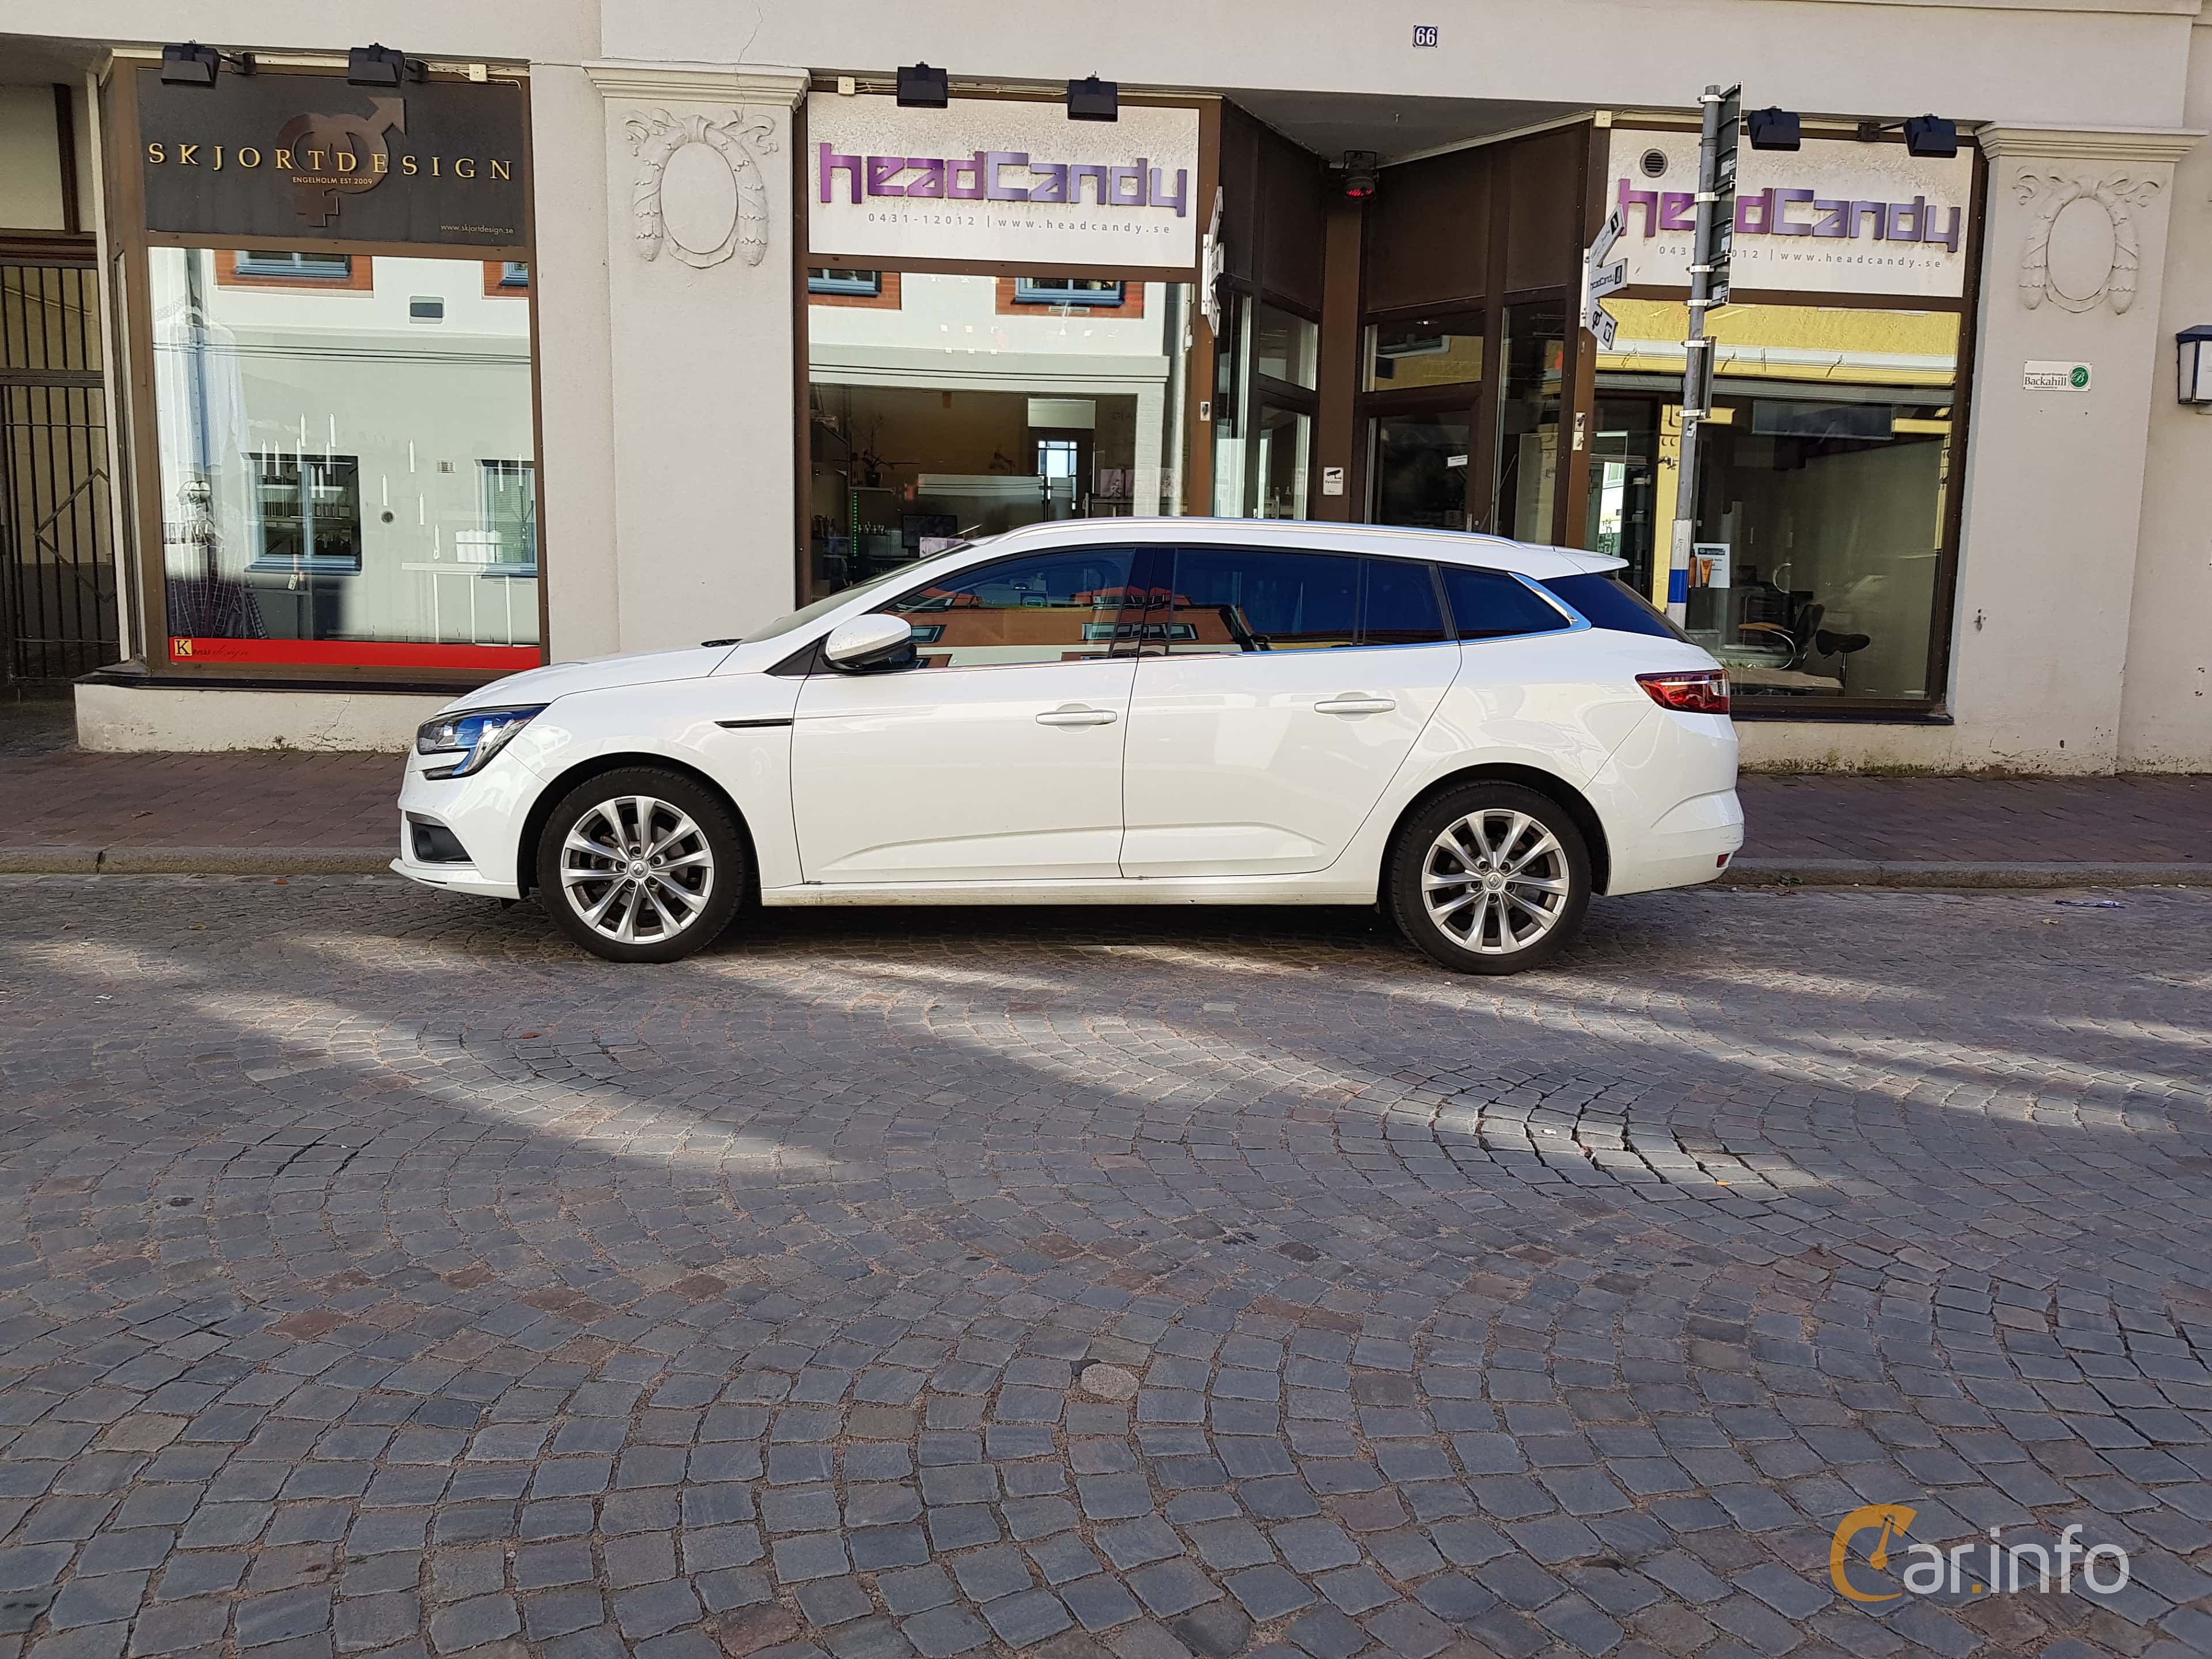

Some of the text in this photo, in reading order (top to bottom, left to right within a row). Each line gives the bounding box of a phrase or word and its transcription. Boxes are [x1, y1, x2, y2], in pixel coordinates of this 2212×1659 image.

[1415, 28, 1435, 45] 66
[148, 142, 512, 180] SKJORTDESIGN
[819, 142, 1187, 217] headCandy
[868, 213, 1171, 234] 0431-12012 www.headcandy.se
[1618, 178, 1961, 253] hedCandy
[440, 223, 514, 235] www.skjortdesign.se
[1659, 246, 1942, 268] 043012 www.headcandy.se
[2025, 376, 2067, 386] Backahill
